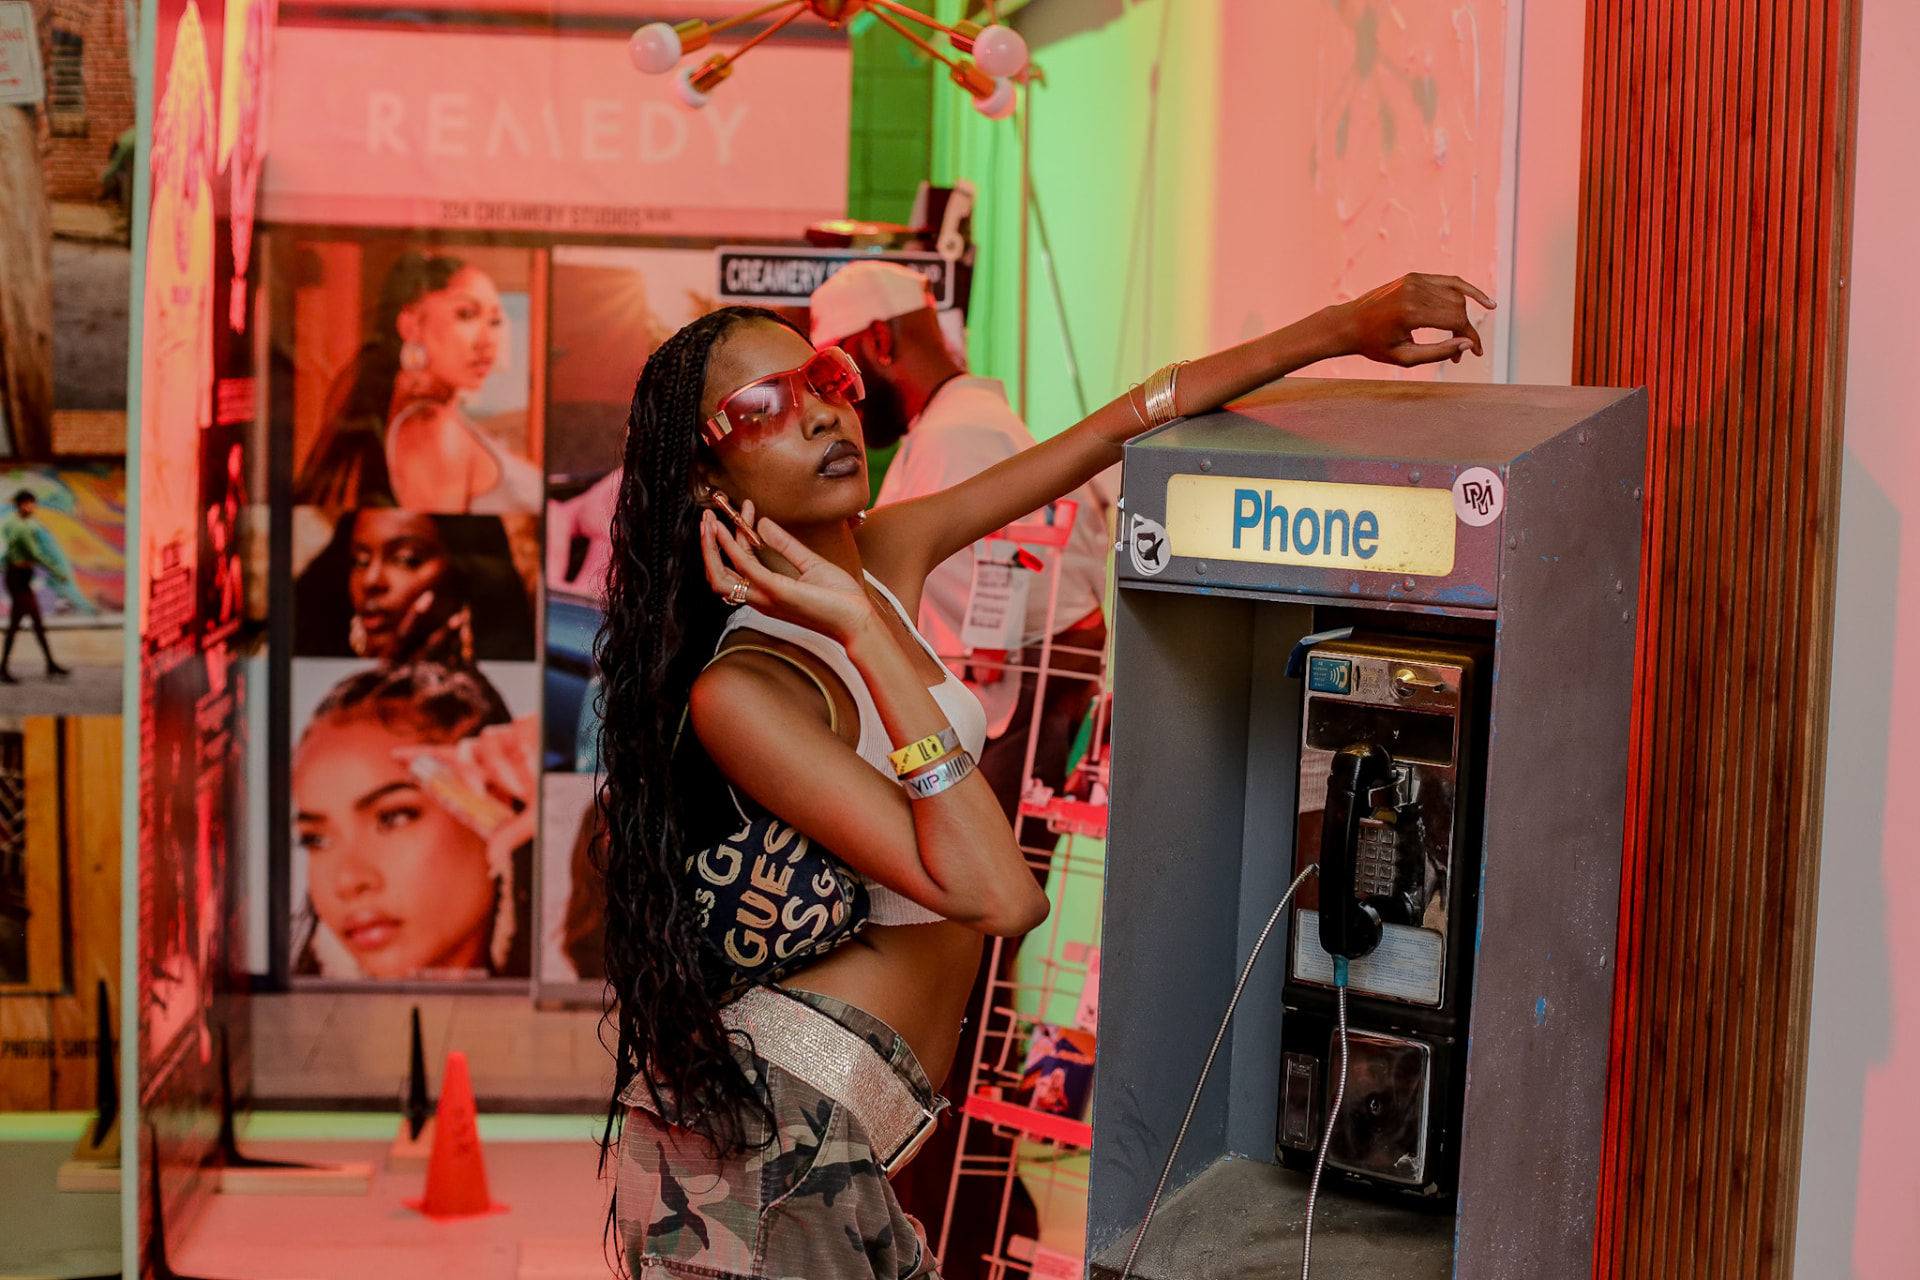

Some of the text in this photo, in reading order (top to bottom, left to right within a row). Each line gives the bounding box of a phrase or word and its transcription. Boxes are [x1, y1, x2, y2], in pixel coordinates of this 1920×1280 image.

[366, 91, 750, 166] REMEDY
[726, 258, 826, 294] CREAMERY
[1232, 488, 1379, 560] Phone
[910, 773, 940, 793] VIP
